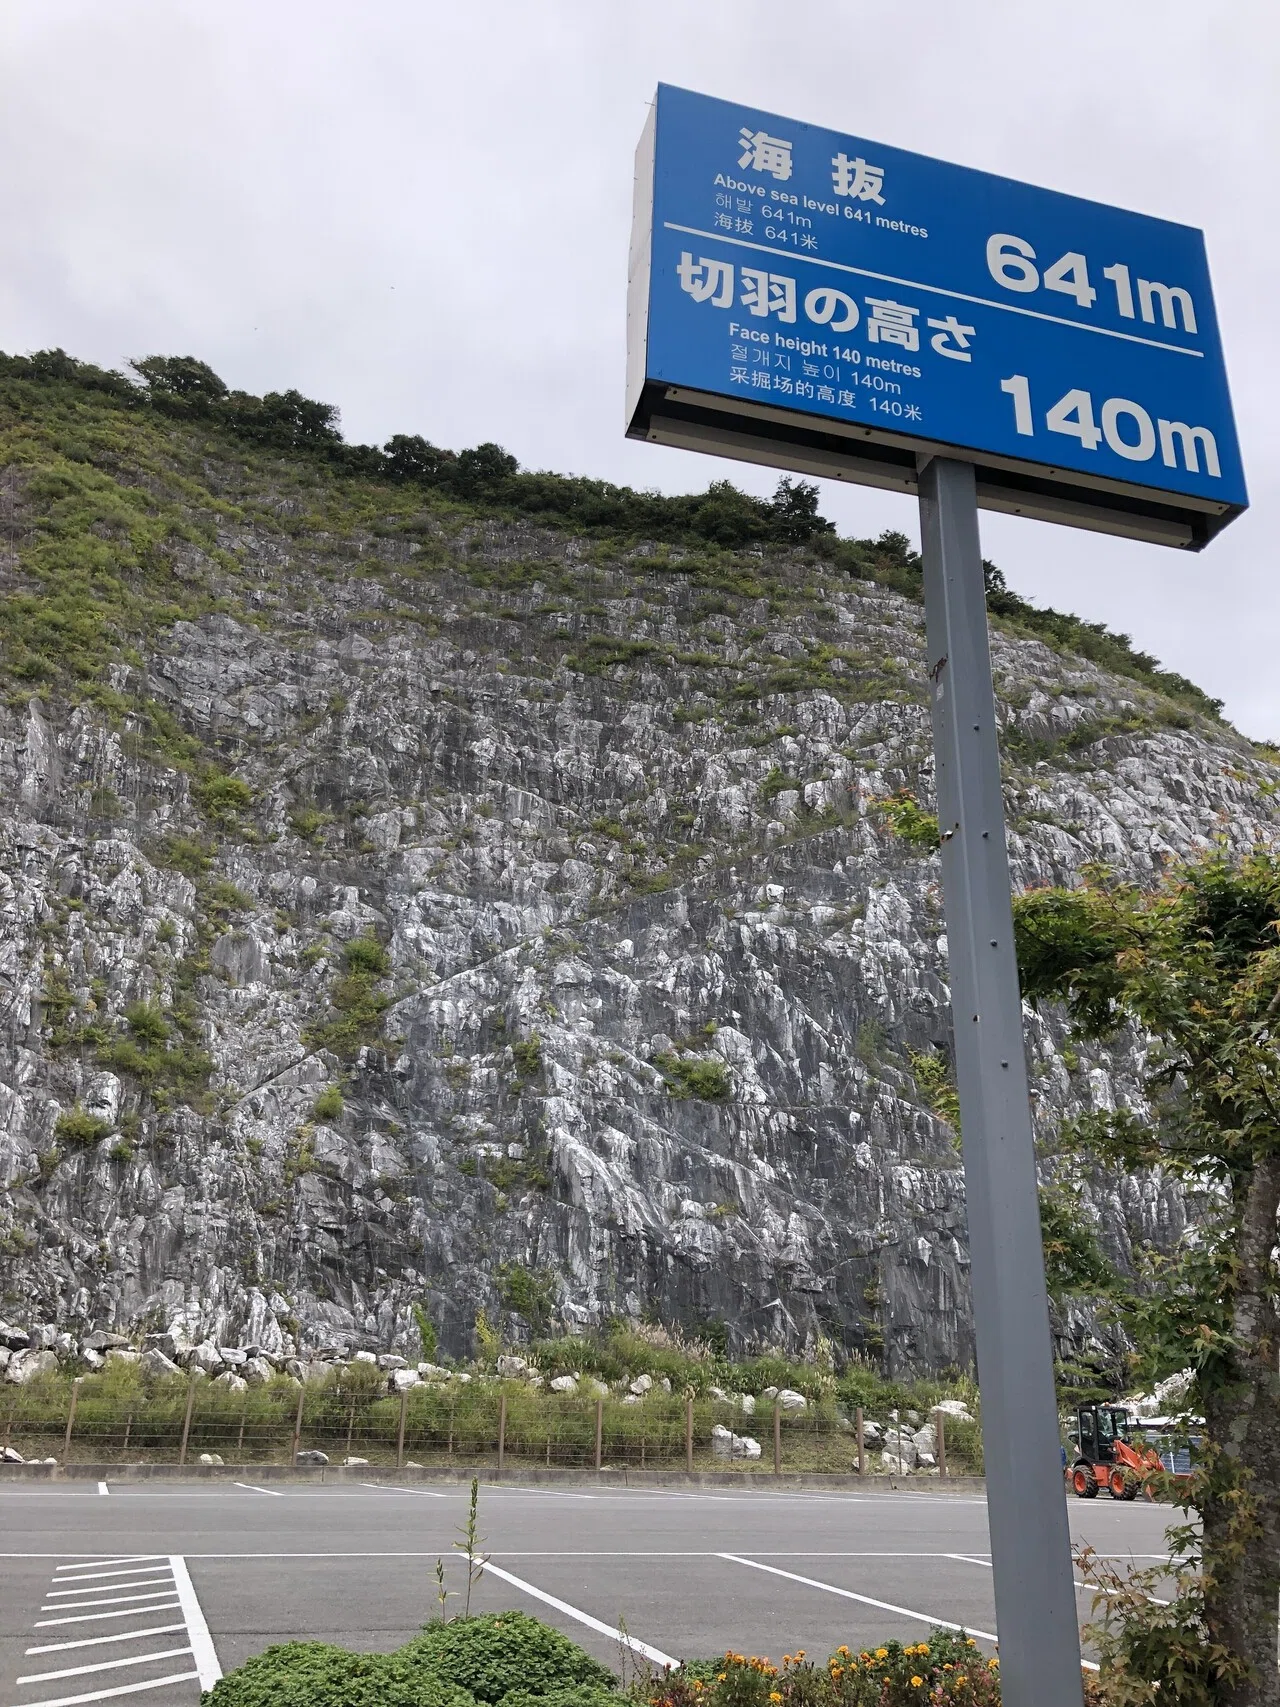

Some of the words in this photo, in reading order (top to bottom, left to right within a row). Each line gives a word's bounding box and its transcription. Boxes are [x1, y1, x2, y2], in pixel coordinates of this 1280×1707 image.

[714, 173, 766, 197] Above
[771, 190, 798, 206] sea
[803, 195, 839, 216] level
[844, 206, 871, 224] 641
[876, 216, 929, 238] metres
[761, 205, 812, 229] 641m
[765, 225, 818, 250] 641米
[676, 251, 977, 363] 切羽の高さ
[986, 233, 1198, 334] 641m
[729, 322, 770, 344] Face
[775, 332, 828, 356] height
[833, 346, 861, 364] 140
[866, 355, 922, 378] metres
[731, 343, 791, 371] 절개지
[802, 359, 840, 382] 높이
[851, 371, 901, 395] 140m
[730, 366, 857, 409] 采掘场的高度
[869, 397, 922, 421] 140米
[1000, 374, 1222, 478] 140m
